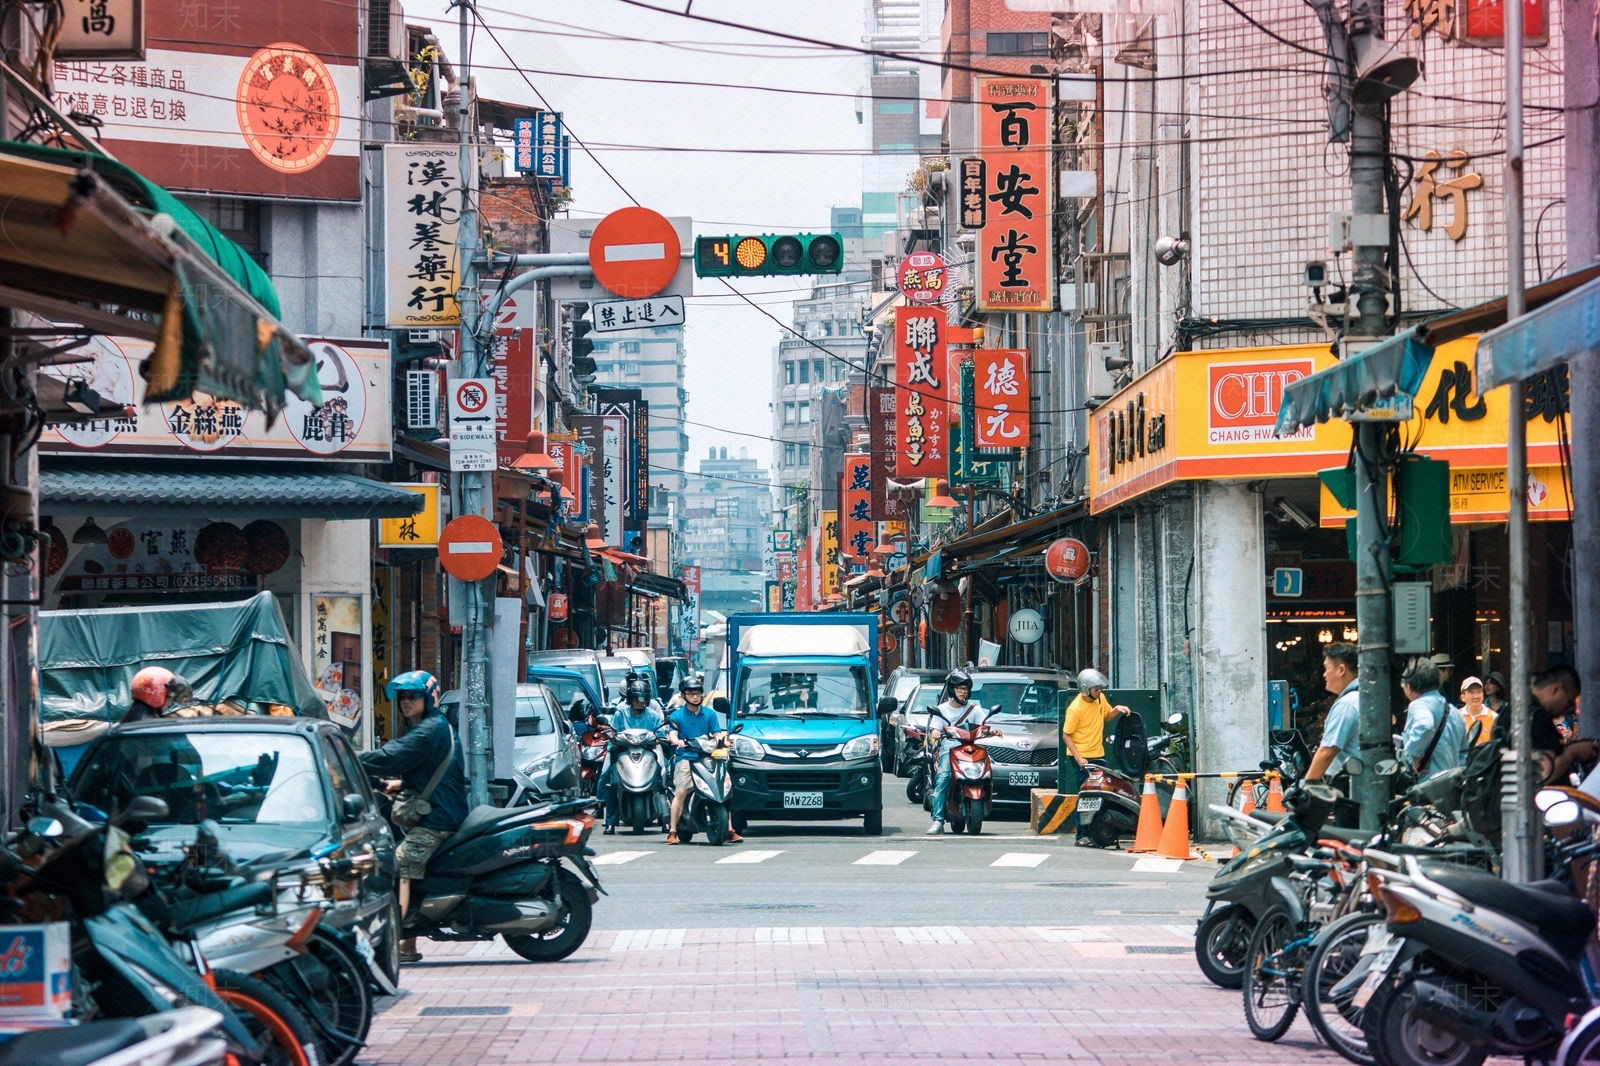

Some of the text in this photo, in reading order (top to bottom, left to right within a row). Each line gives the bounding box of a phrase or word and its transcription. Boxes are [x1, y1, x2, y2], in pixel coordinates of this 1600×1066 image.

[53, 90, 187, 121] 不滿意包退包換
[988, 101, 1040, 289] 百安堂
[713, 243, 729, 266] 4
[903, 267, 943, 290] 燕窩
[600, 303, 680, 328] 禁止進入
[983, 357, 1021, 439] 德元
[167, 403, 243, 436] 金絲燕
[301, 412, 350, 442] 鹿茸
[928, 408, 942, 460] からすみ
[1210, 429, 1251, 442] CHANG
[1453, 472, 1504, 491] ATM SERVICE
[849, 464, 873, 557] 萬安堂
